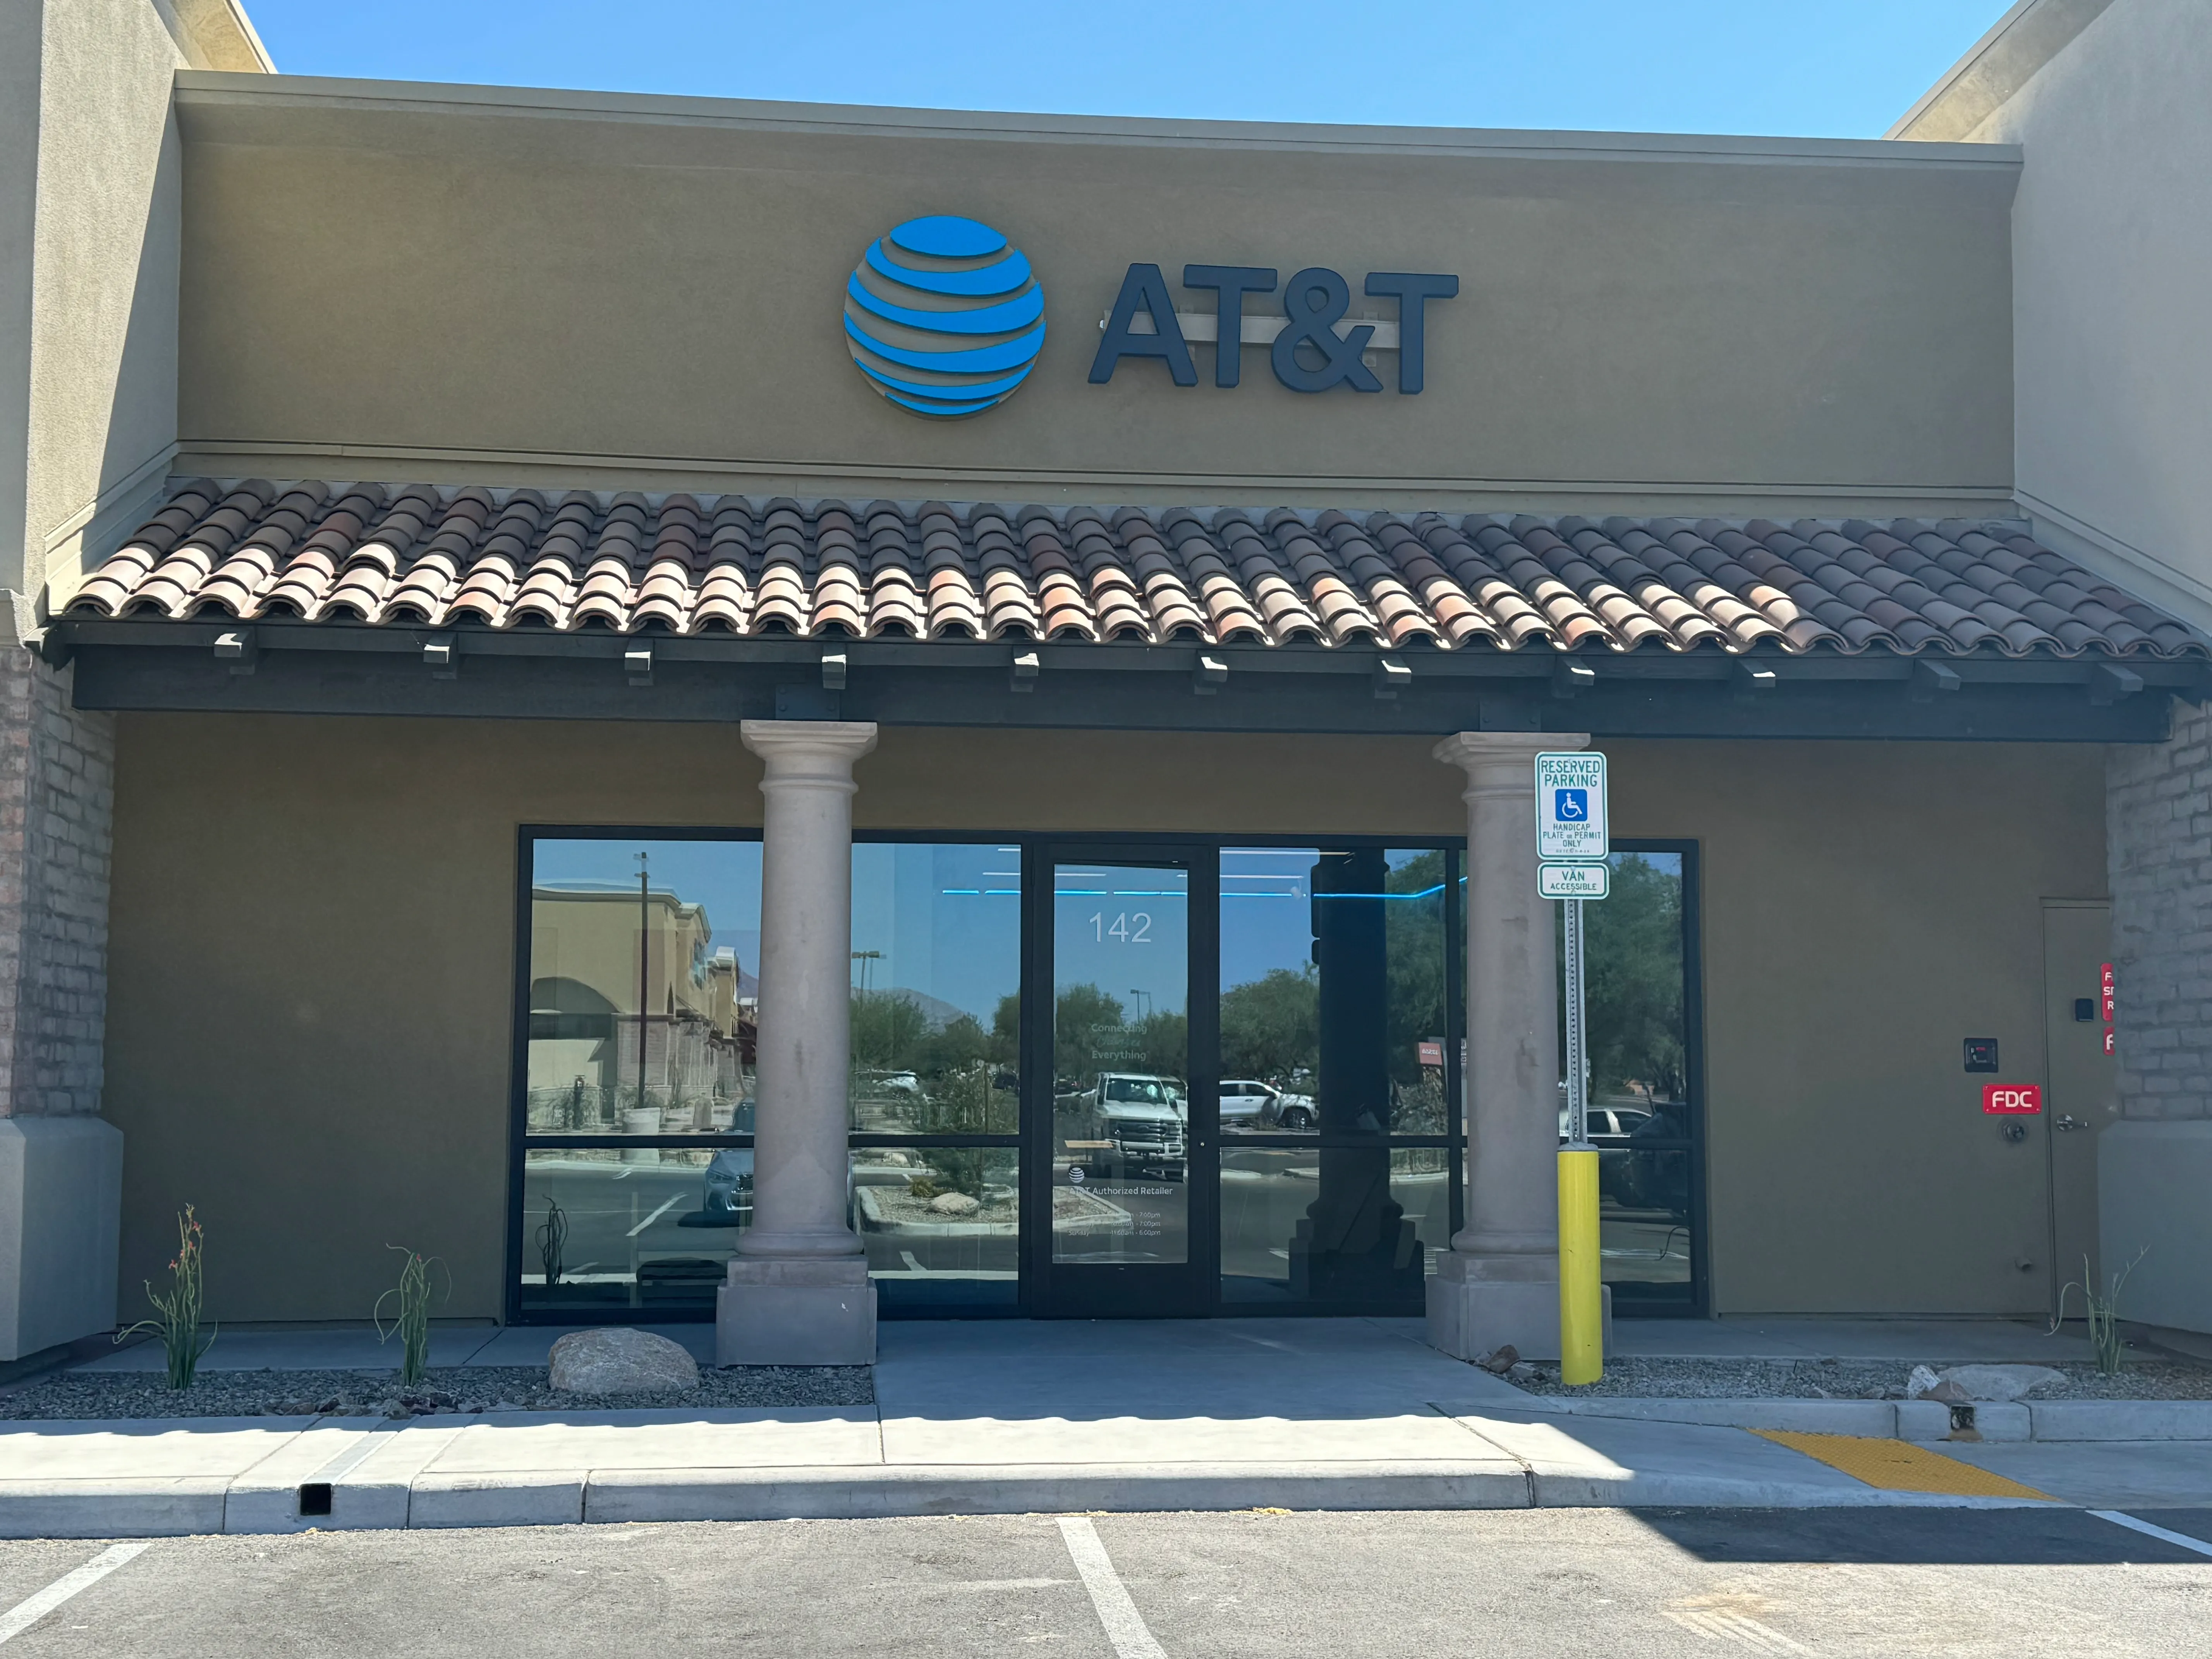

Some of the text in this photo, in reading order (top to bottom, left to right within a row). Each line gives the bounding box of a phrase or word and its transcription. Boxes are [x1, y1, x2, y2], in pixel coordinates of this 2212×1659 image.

[1088, 263, 1458, 395] AT&T
[1541, 761, 1600, 773] RESERVED
[1545, 774, 1597, 787] PARKING
[1562, 871, 1584, 881] VAN
[1089, 912, 1151, 942] 142
[1091, 1023, 1147, 1035] Connecting
[1092, 1050, 1146, 1061] Everything
[1992, 1091, 2032, 1107] FDC
[1092, 1187, 1139, 1195] Authorized
